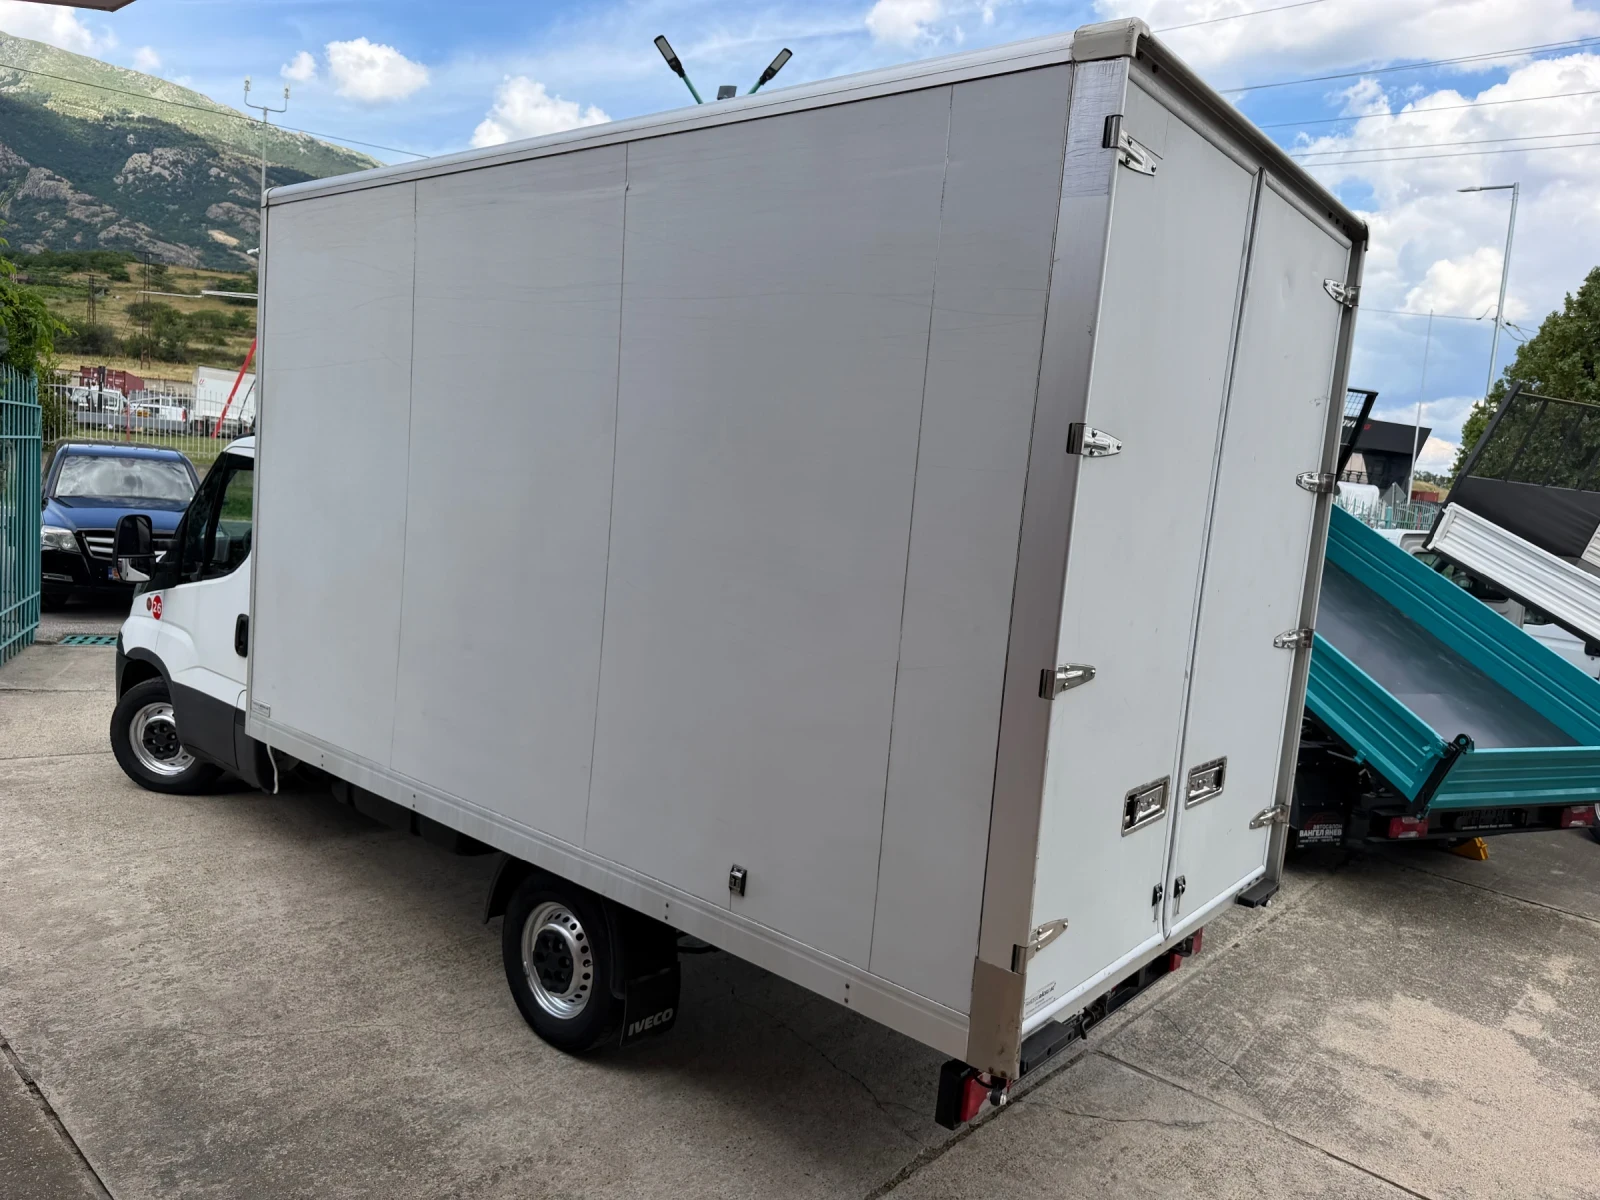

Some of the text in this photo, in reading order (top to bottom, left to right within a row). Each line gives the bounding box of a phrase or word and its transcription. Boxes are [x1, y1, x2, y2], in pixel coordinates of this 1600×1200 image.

[153, 601, 162, 614] 26
[1299, 829, 1324, 837] ВАНГЕЛ
[628, 1007, 674, 1037] IVECO
